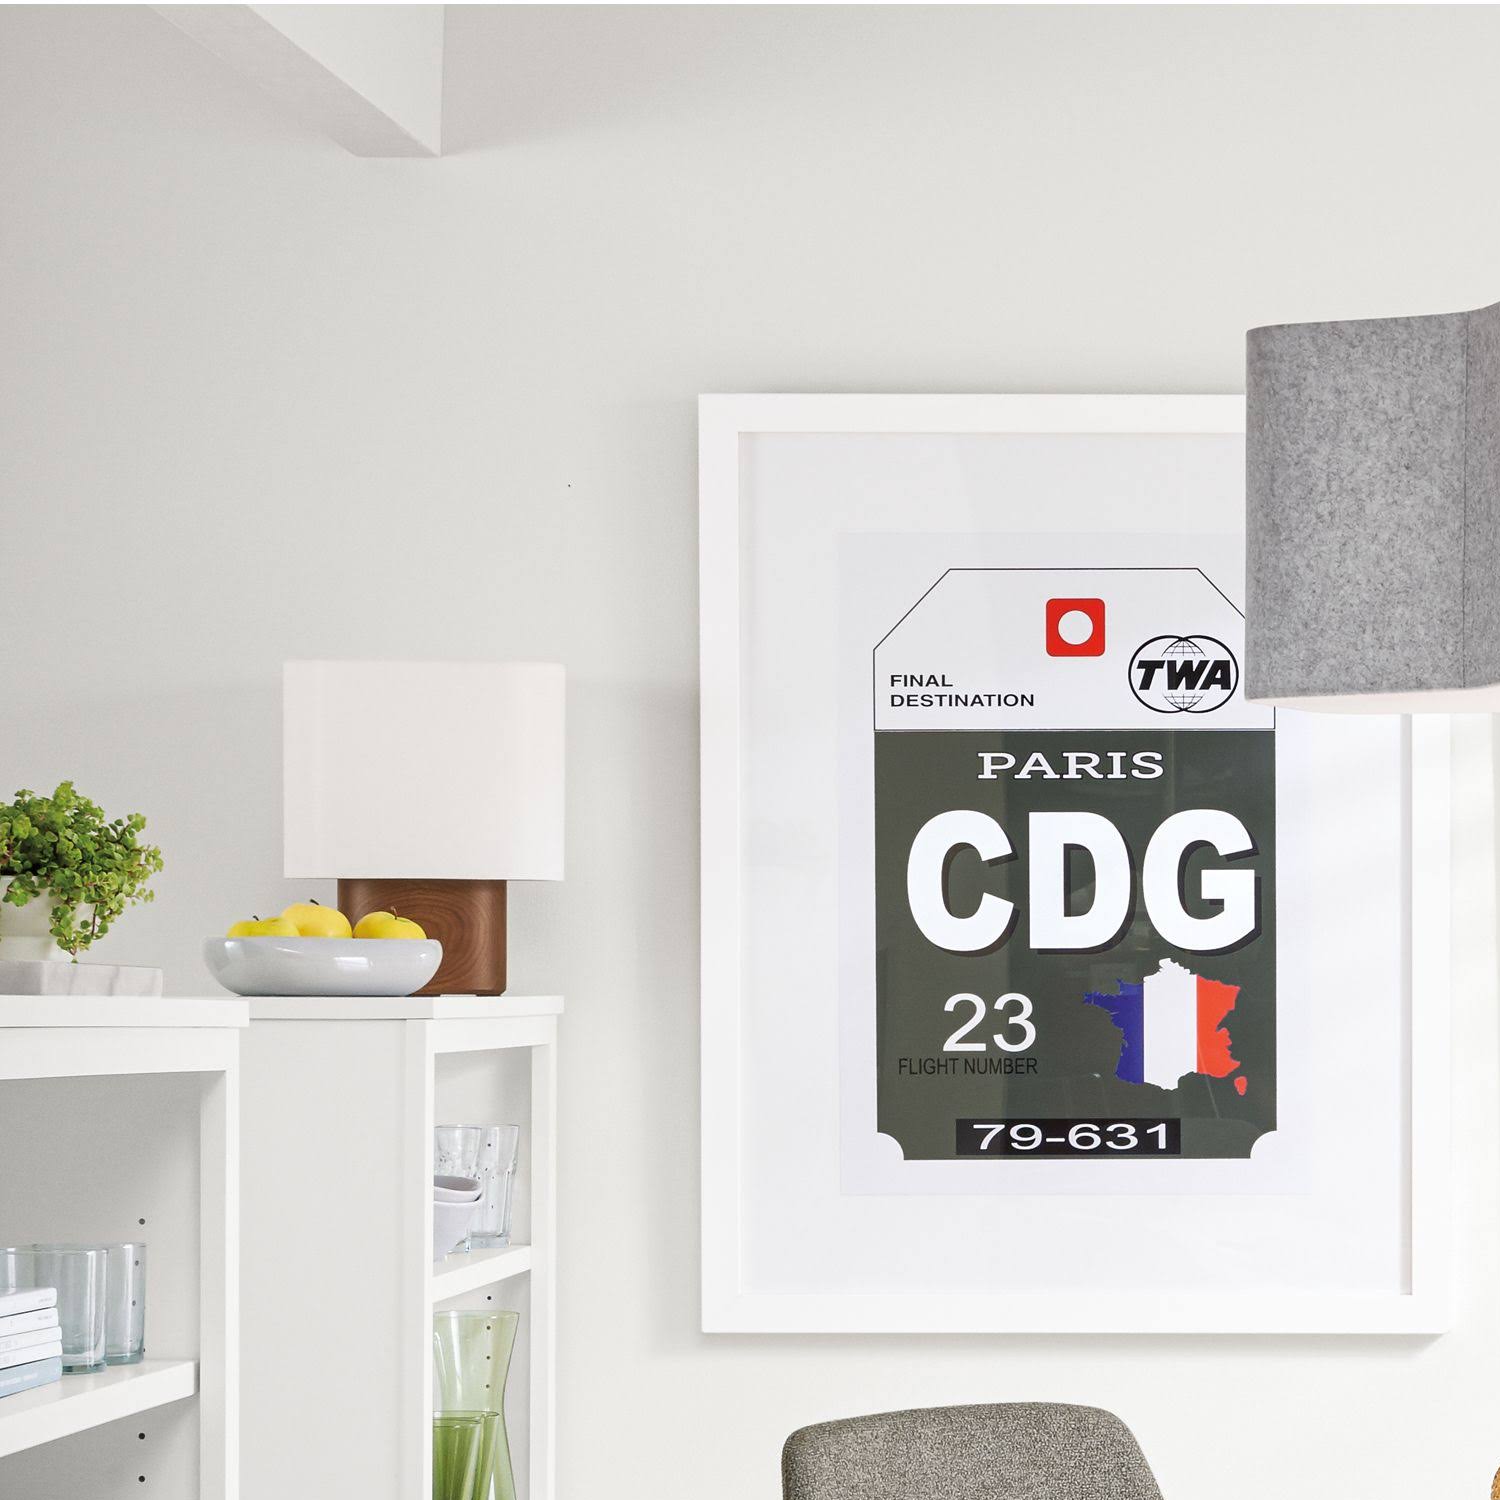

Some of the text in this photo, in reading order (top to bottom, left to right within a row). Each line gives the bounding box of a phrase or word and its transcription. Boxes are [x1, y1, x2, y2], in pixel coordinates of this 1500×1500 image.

[890, 674, 953, 688] FINAL
[1136, 659, 1232, 692] TWA
[890, 693, 1035, 707] DESTINATION
[977, 751, 1164, 780] PARIS
[906, 808, 1262, 957] CDG
[942, 992, 1037, 1053] 23
[898, 1058, 1038, 1075] FLIGHT NUMBER
[973, 1122, 1168, 1151] 79-631
